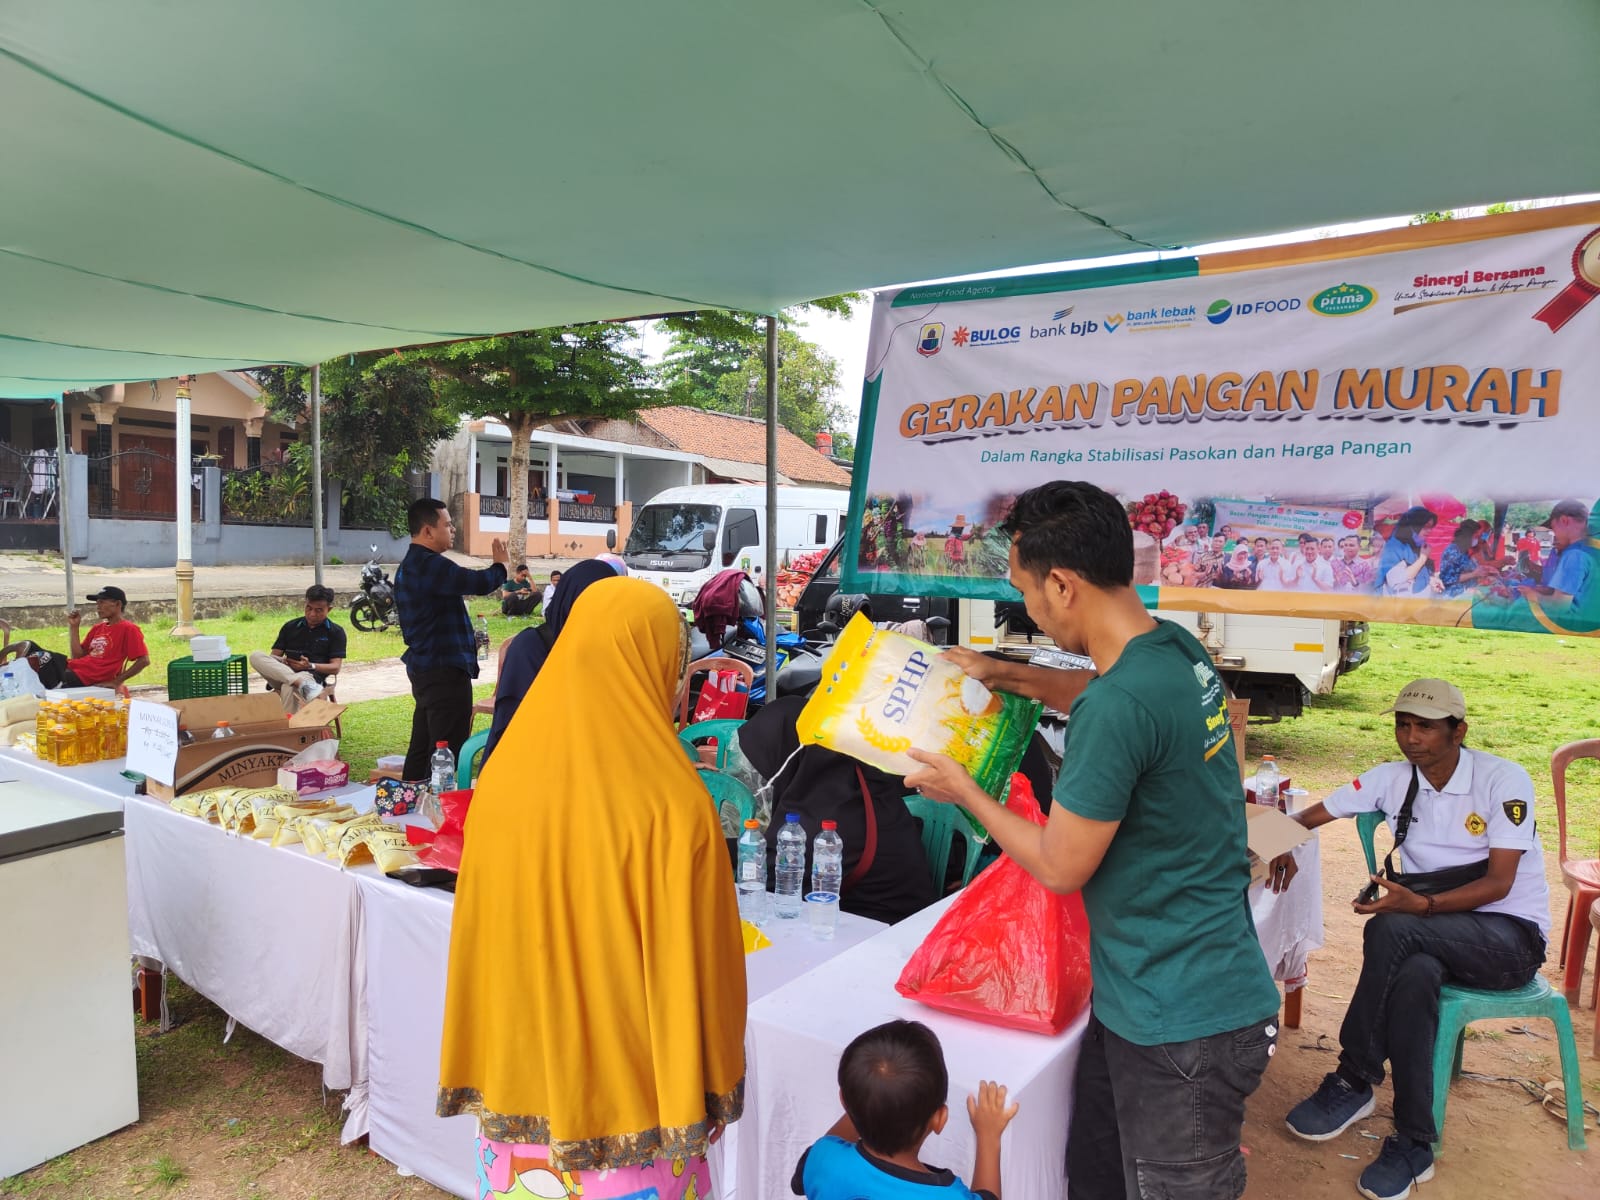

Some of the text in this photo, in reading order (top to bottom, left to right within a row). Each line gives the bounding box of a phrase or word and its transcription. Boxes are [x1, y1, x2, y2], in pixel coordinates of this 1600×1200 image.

[1413, 266, 1545, 287] Sinergi Bersama
[945, 287, 965, 297] Food
[966, 285, 996, 297] Agency
[1236, 298, 1301, 315] ID FOOD
[1320, 294, 1364, 308] prima
[1127, 304, 1196, 321] bank lebak
[970, 326, 1021, 342] BULOG
[1030, 320, 1099, 339] bank bjb
[899, 364, 1563, 440] GERAKAN PANGAN MURAH
[981, 440, 1412, 464] Dalam Rangka Stabilisasi Pasokan dan Harga Pangan
[650, 559, 674, 567] ISUZU
[883, 650, 930, 723] SPHP
[218, 755, 294, 783] MINYAKIT
[1512, 805, 1521, 819] 9
